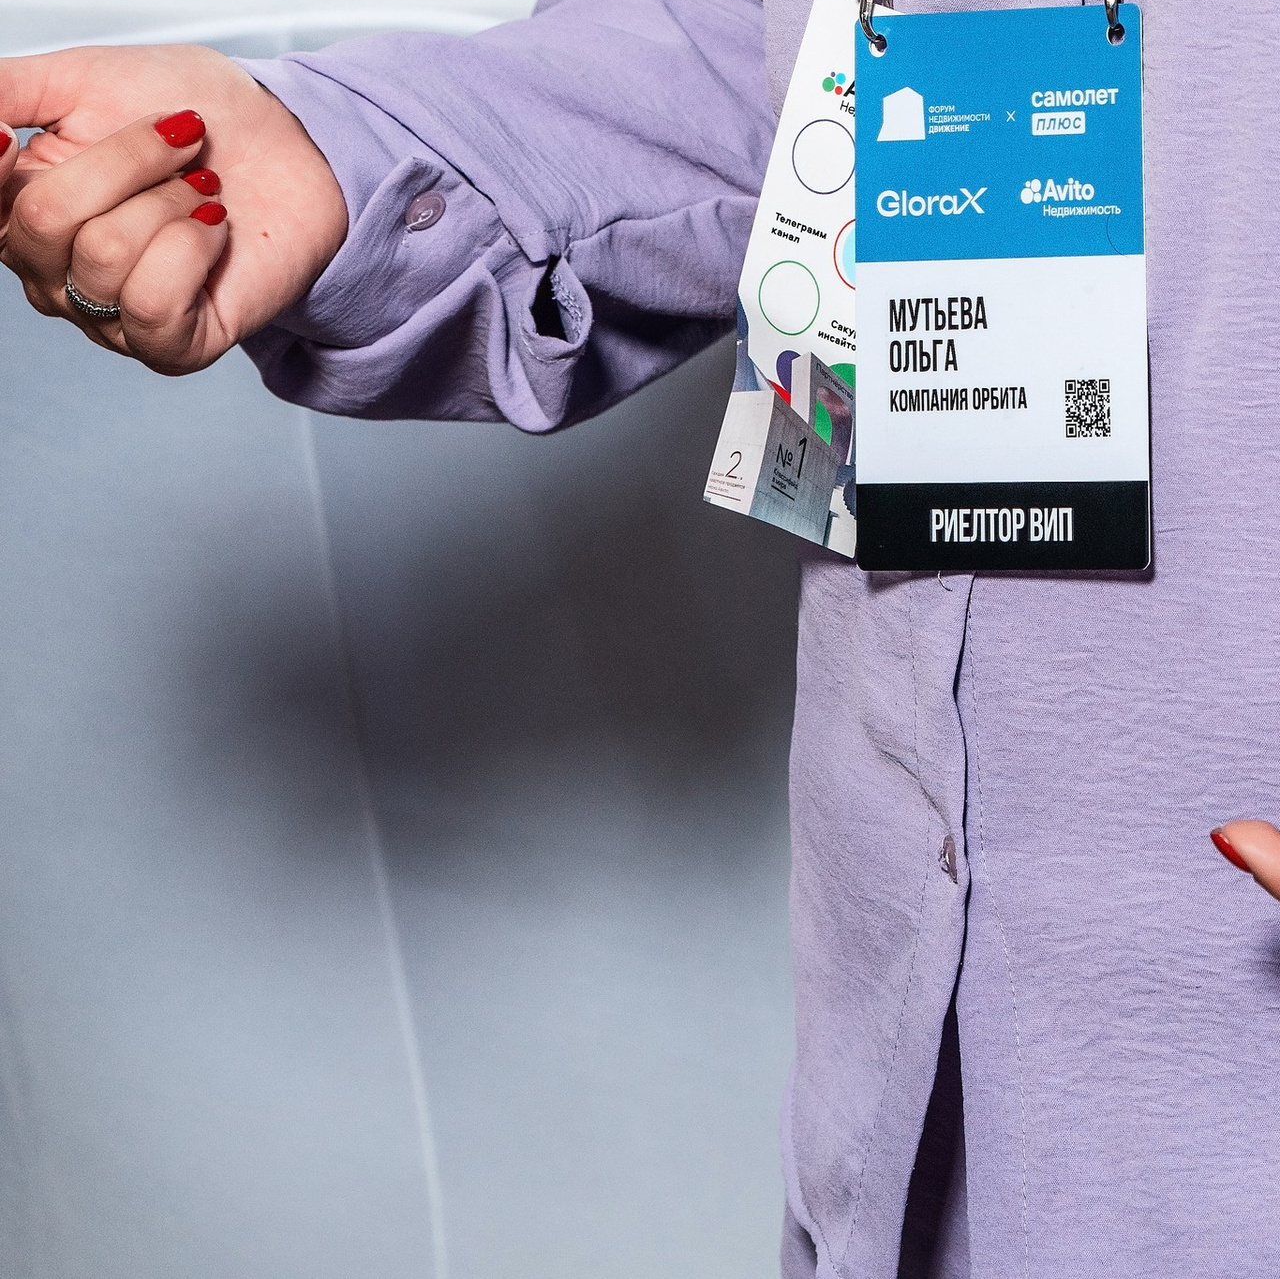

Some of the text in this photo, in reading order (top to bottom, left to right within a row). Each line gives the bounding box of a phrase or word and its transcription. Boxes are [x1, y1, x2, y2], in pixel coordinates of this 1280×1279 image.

[928, 105, 956, 114] ФОРУМ
[1031, 88, 1119, 108] самолет
[928, 112, 991, 124] НЕДВИЖИМОСТИ
[928, 123, 970, 134] ДВИЖЕНИЕ
[877, 187, 988, 217] GloraX
[1042, 177, 1095, 202] Avito
[1043, 204, 1122, 218] Недвижимость
[771, 226, 801, 244] канал
[775, 212, 828, 239] Телеграмм
[889, 296, 988, 333] МУТЬЕВА
[889, 338, 959, 373] ОЛЬГА
[890, 386, 1028, 412] КОМПАНИЯ ОРБИТА
[931, 507, 1074, 543] РИЕЛТОР ВИП
